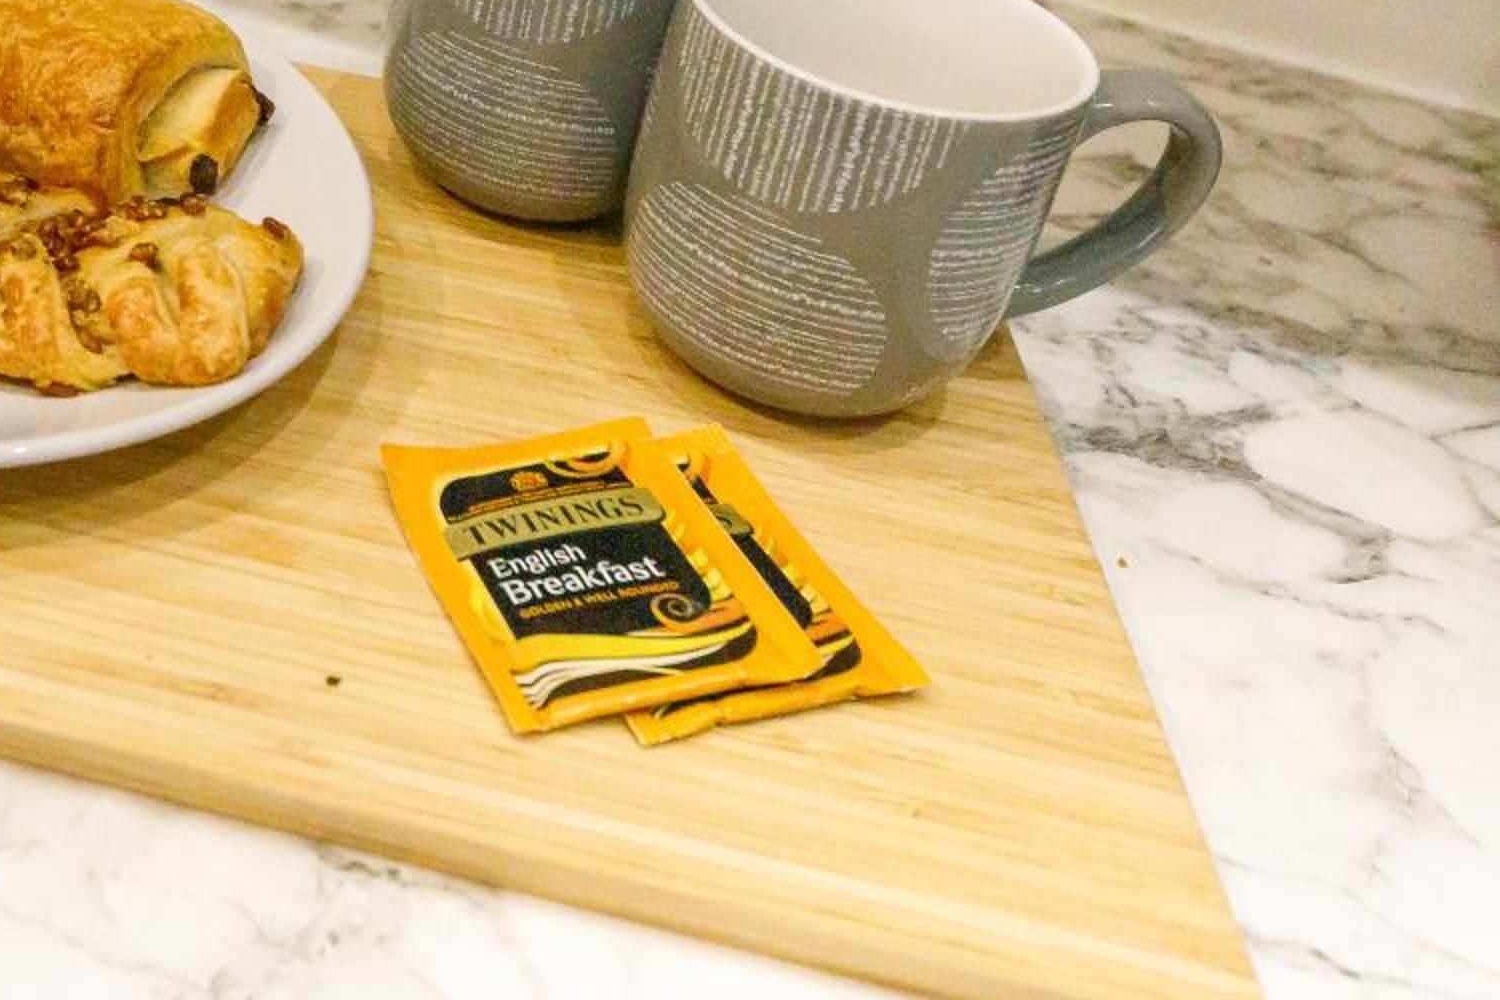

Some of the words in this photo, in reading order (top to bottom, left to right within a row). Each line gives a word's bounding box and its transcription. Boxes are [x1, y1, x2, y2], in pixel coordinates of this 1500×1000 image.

[466, 494, 644, 545] TWININGS
[488, 544, 587, 579] English
[499, 556, 666, 605] Breakfast
